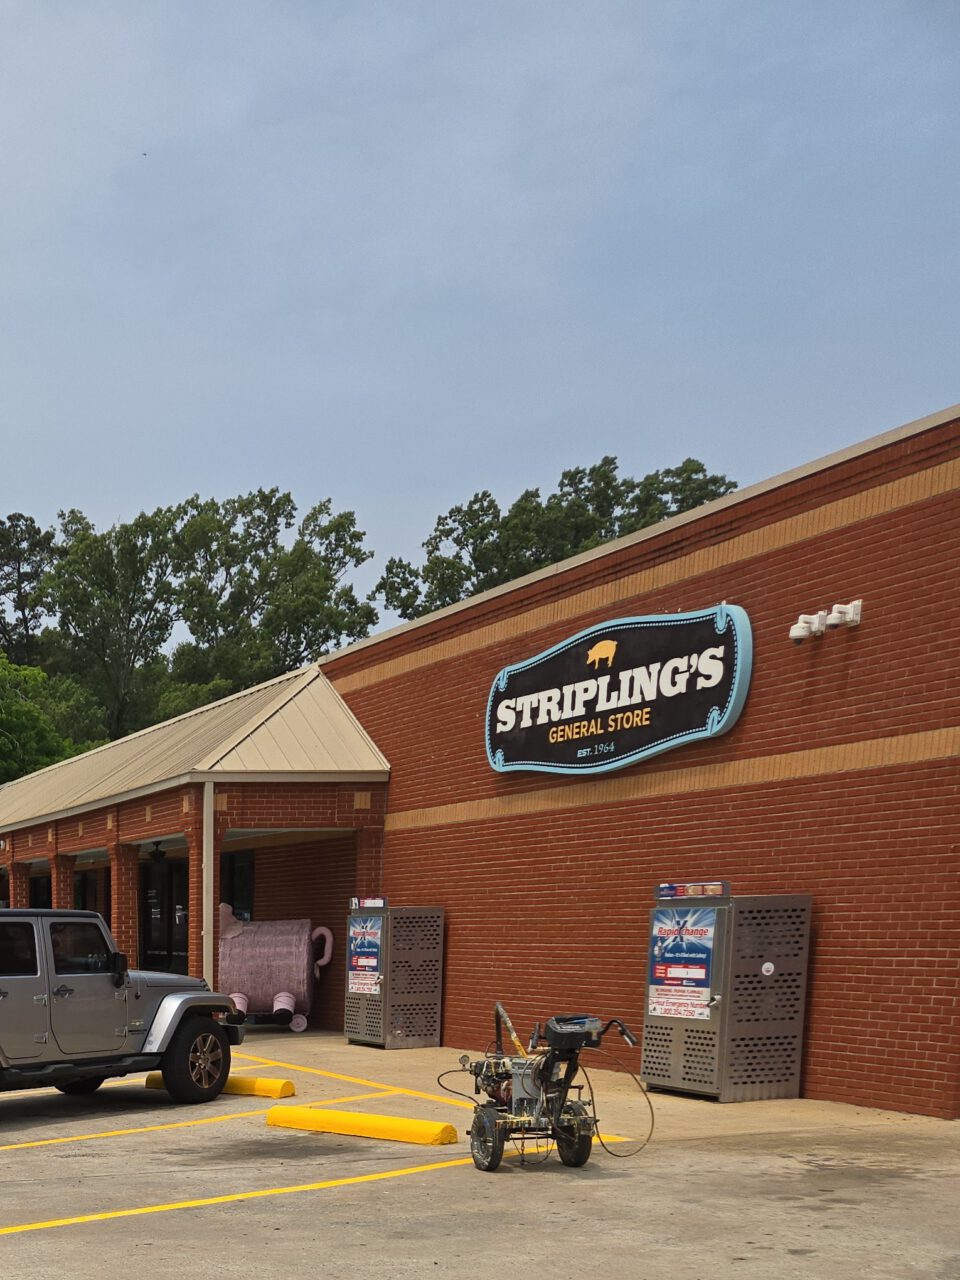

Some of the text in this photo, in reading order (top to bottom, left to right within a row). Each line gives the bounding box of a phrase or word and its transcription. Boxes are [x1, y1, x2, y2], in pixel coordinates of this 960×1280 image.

[496, 645, 725, 733] STRIPLING'S
[549, 708, 651, 744] GENERAL STORE
[577, 742, 615, 758] EST. 1964
